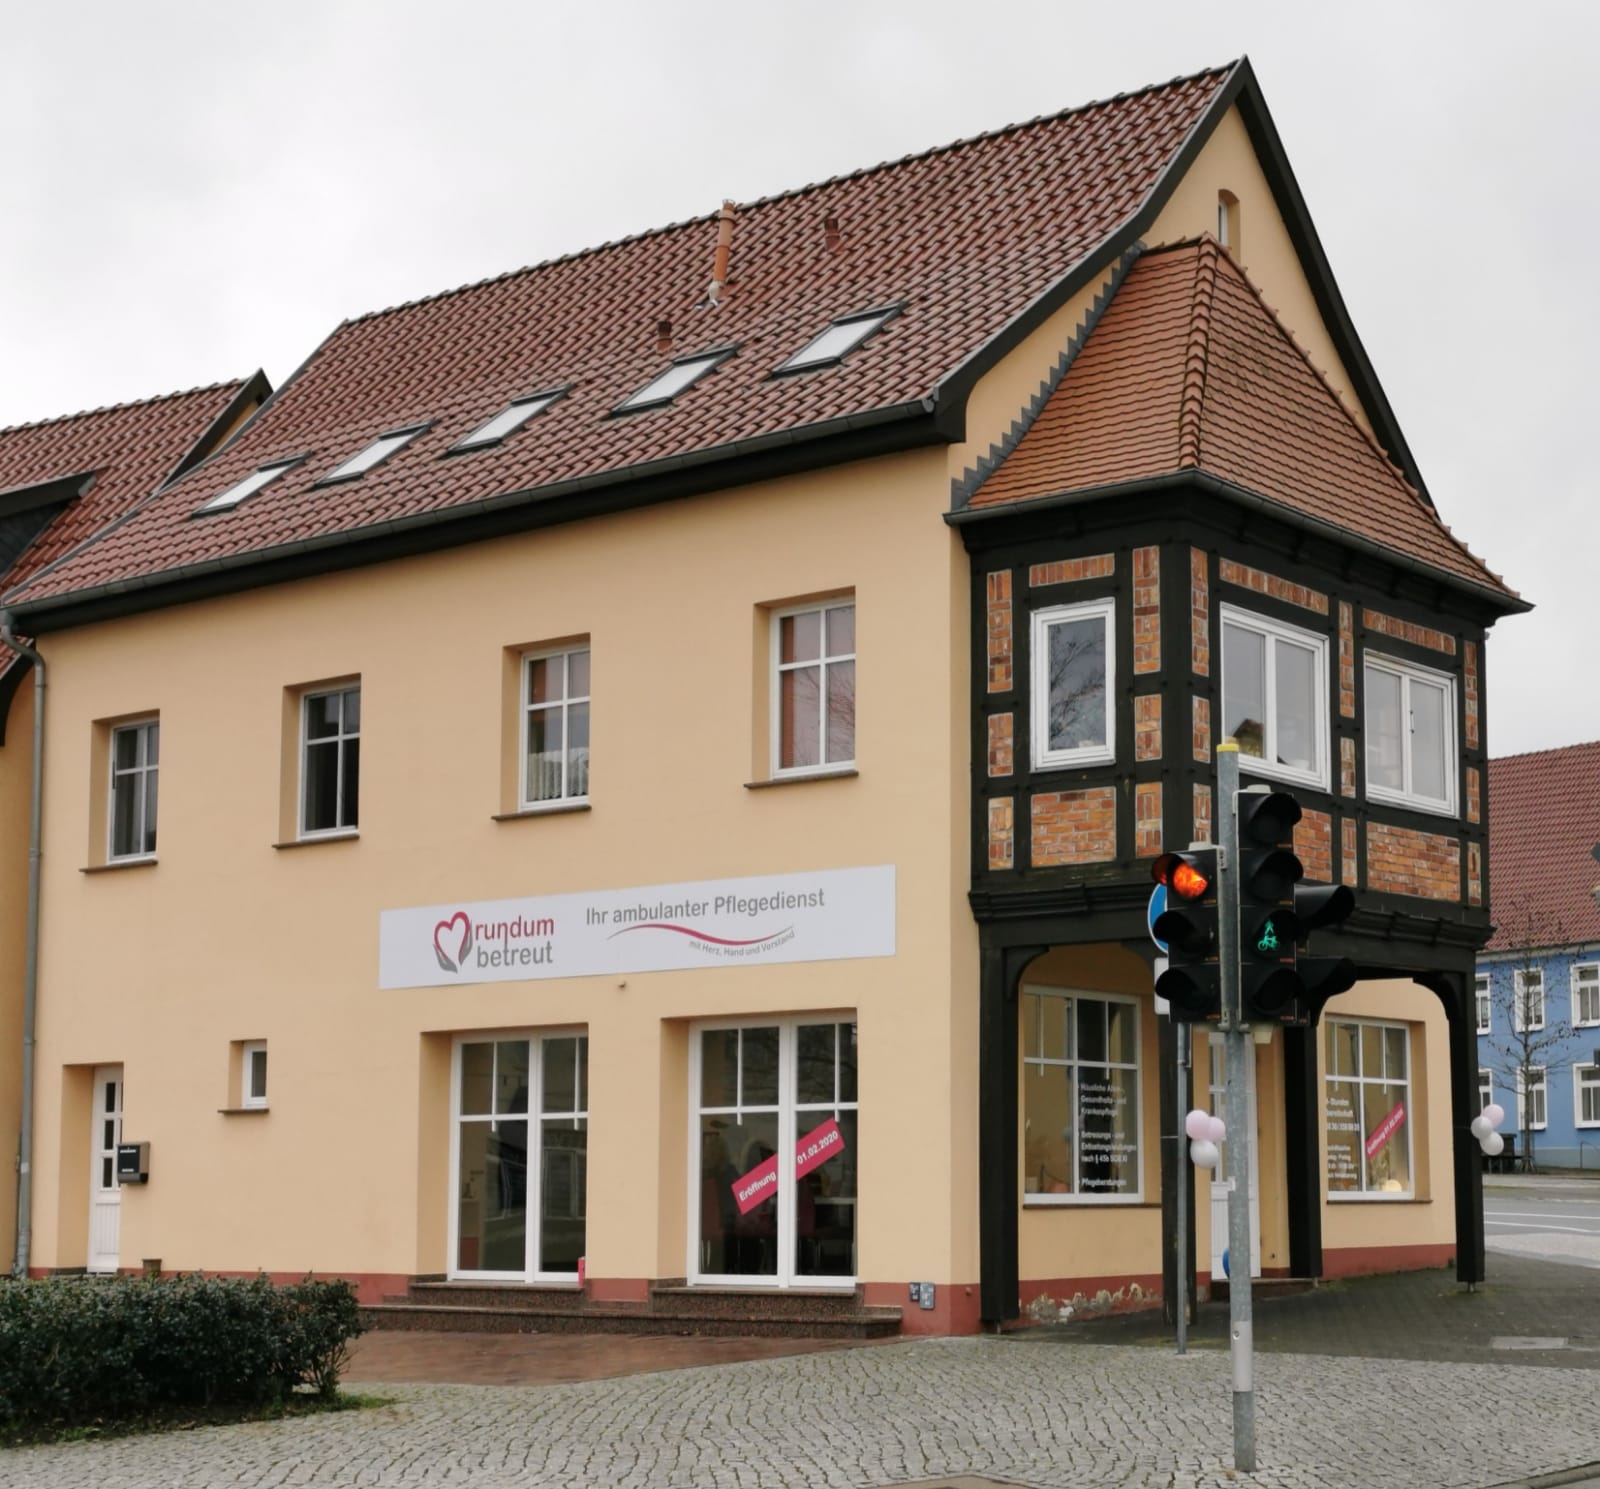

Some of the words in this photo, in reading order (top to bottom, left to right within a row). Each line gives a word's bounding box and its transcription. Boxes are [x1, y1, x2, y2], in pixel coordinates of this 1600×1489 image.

[586, 906, 608, 925] Ihr
[612, 899, 709, 923] ambulanter
[714, 887, 825, 917] Pflegedienst
[475, 914, 555, 944] rundum
[476, 940, 554, 968] betreut
[723, 945, 745, 957] Hand
[739, 1172, 776, 1201] Eröffnung
[797, 1131, 838, 1164] 01.02.2020
